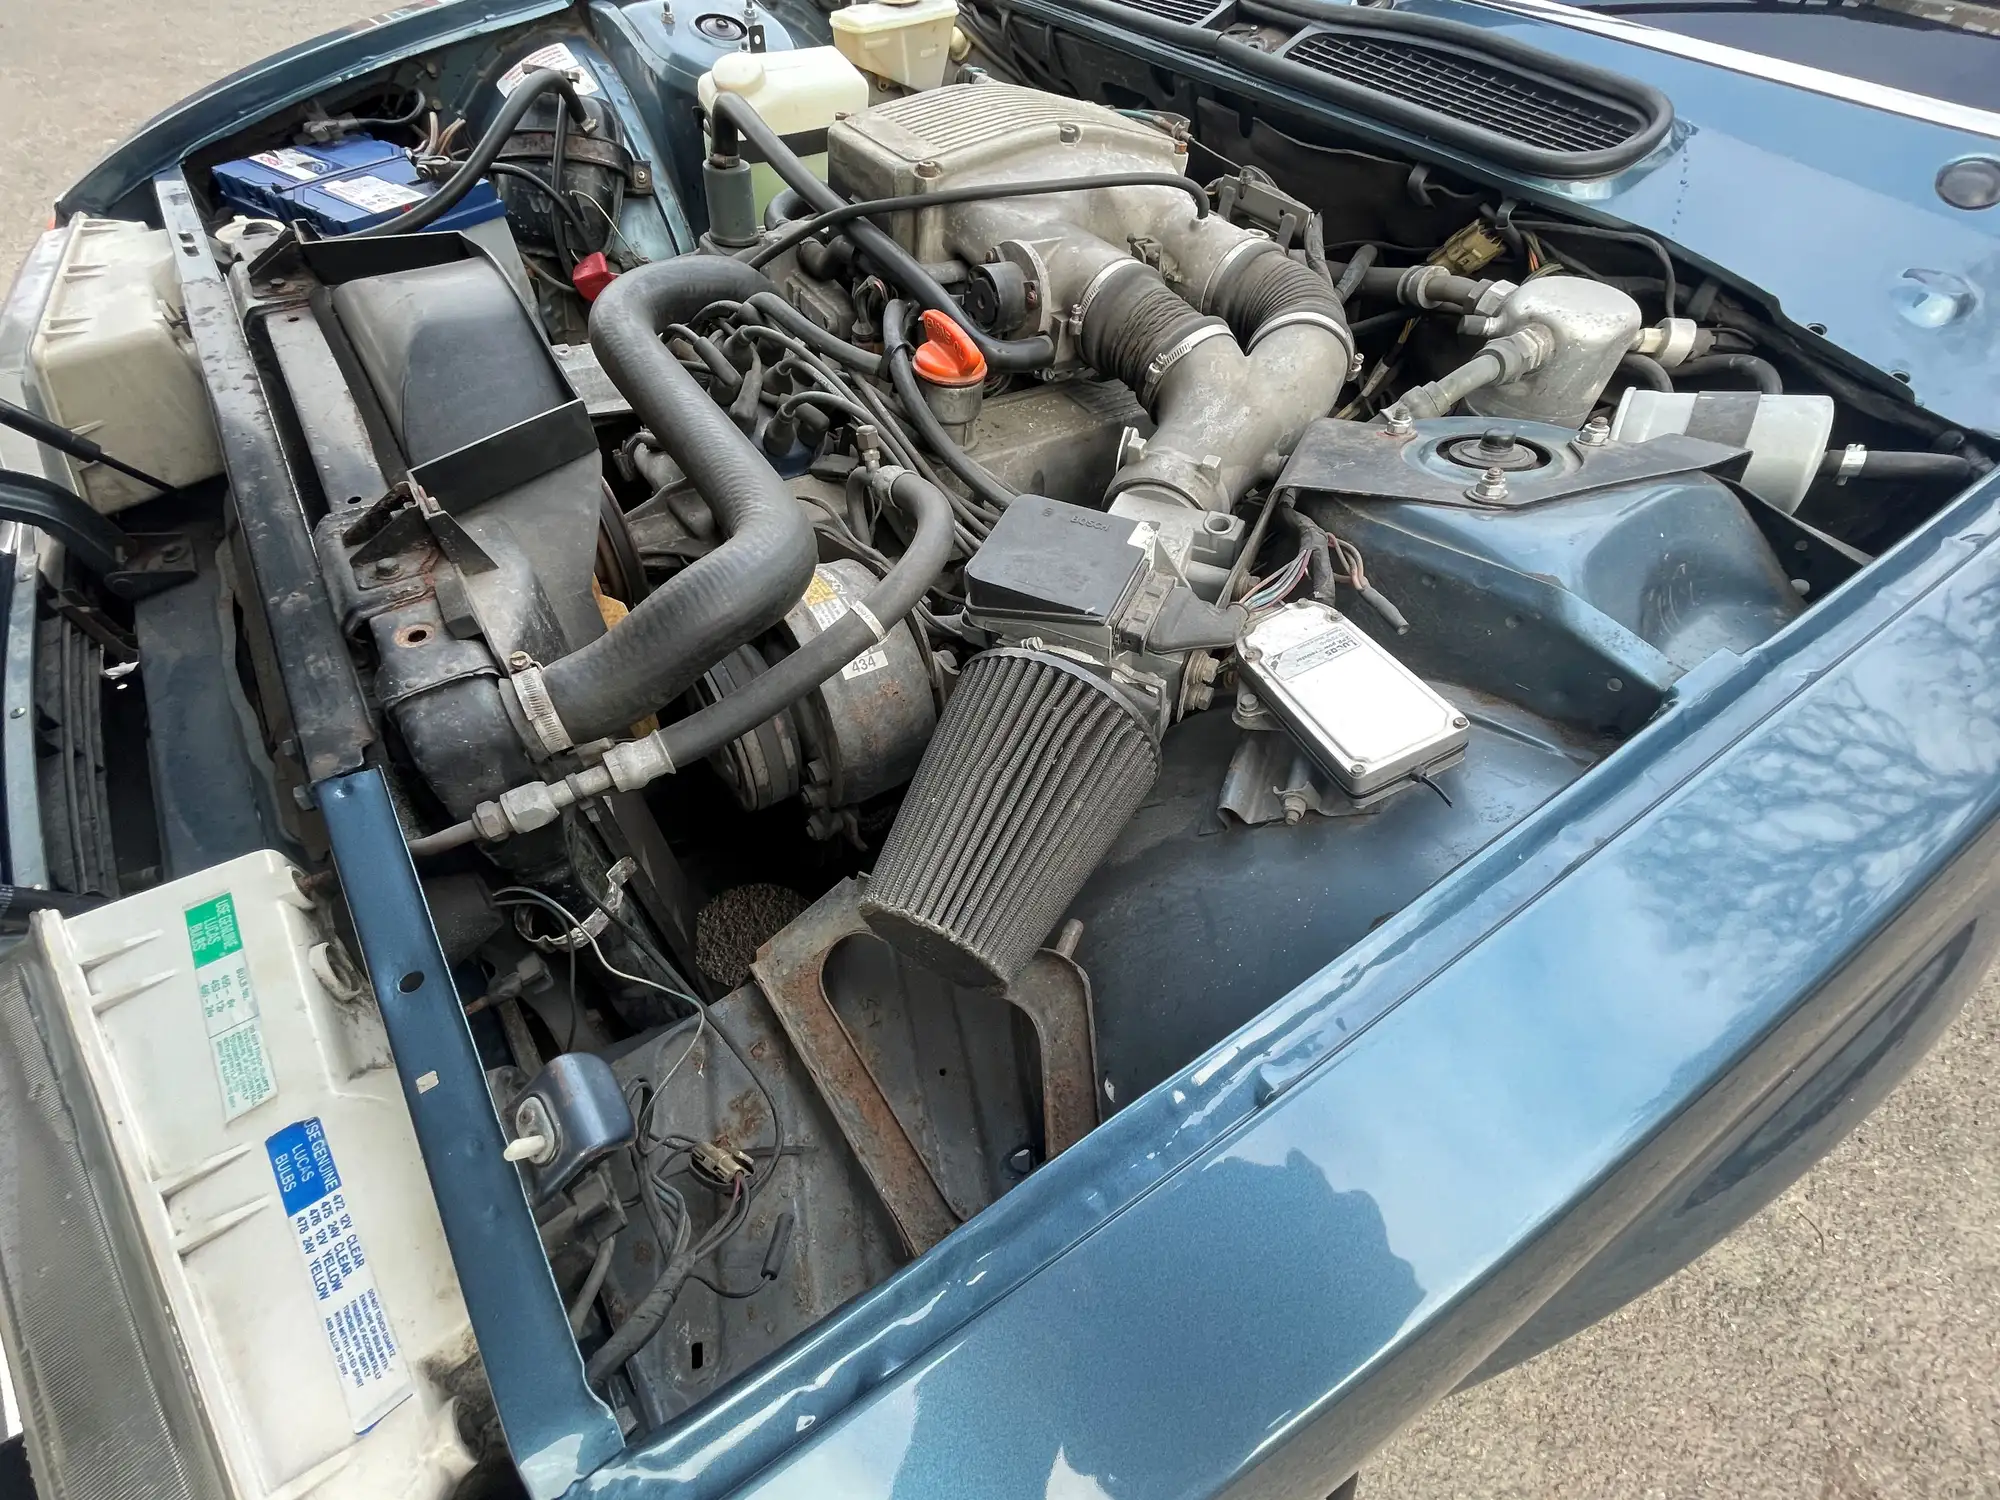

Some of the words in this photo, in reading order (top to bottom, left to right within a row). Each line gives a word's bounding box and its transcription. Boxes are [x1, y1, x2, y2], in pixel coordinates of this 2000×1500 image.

[1070, 516, 1110, 532] BOSCH
[852, 655, 876, 673] 434
[216, 900, 229, 915] USE
[190, 922, 206, 952] BULBS
[205, 917, 220, 944] LUCAS
[220, 914, 237, 948] GENUINE
[236, 967, 247, 987] BULB
[303, 1117, 321, 1141] USE
[274, 1152, 298, 1193] BULBS
[292, 1142, 315, 1182] LUCAS
[311, 1138, 338, 1191] GENUINE
[308, 1207, 322, 1226] 476
[320, 1199, 334, 1218] 475
[296, 1215, 309, 1234] 478
[327, 1220, 341, 1239] 24V
[332, 1193, 345, 1211] 472
[340, 1213, 352, 1230] 12V
[346, 1233, 365, 1268] CLEAR
[302, 1236, 316, 1255] 24V
[315, 1228, 328, 1246] 12V
[333, 1241, 353, 1277] CLEAR
[308, 1257, 331, 1301] YELLOW
[321, 1249, 343, 1292] YELLOW
[334, 1311, 344, 1327] WITH
[359, 1294, 374, 1325] ENVELOPE
[325, 1316, 334, 1330] AND
[370, 1325, 377, 1334] OF
[375, 1311, 387, 1332] TOUCH
[382, 1331, 396, 1357] QUARTZ
[329, 1330, 341, 1352] ALLOW
[338, 1326, 357, 1368] METHYLATED
[373, 1334, 383, 1352] BULB
[336, 1353, 344, 1363] TO
[352, 1334, 362, 1351] WIPE
[358, 1352, 371, 1377] GENTLY
[361, 1333, 382, 1380] ACCIDENTALLY
[379, 1351, 389, 1369] WITH
